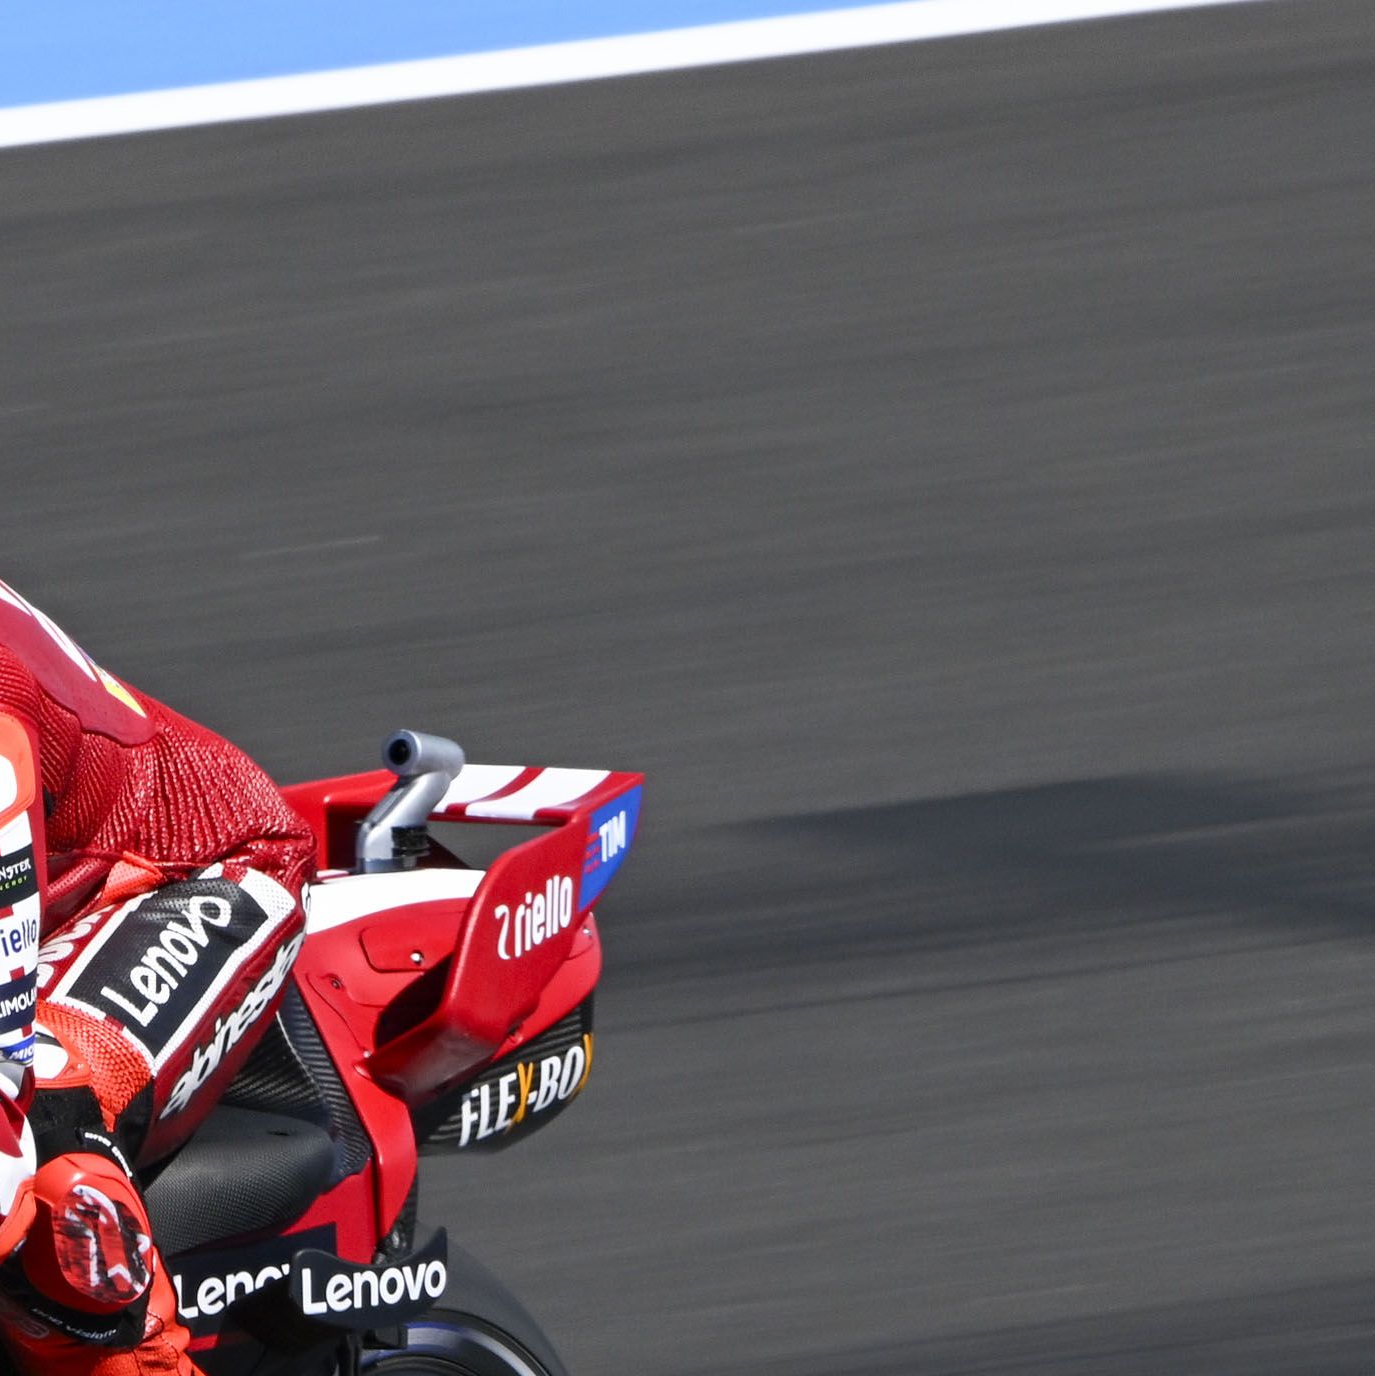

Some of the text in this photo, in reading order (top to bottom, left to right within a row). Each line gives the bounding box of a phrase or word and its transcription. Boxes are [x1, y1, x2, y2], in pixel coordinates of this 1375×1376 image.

[598, 810, 627, 863] TIM
[514, 874, 574, 958] riello
[99, 895, 232, 1028] Lenovo
[301, 1259, 448, 1316] Lenovo
